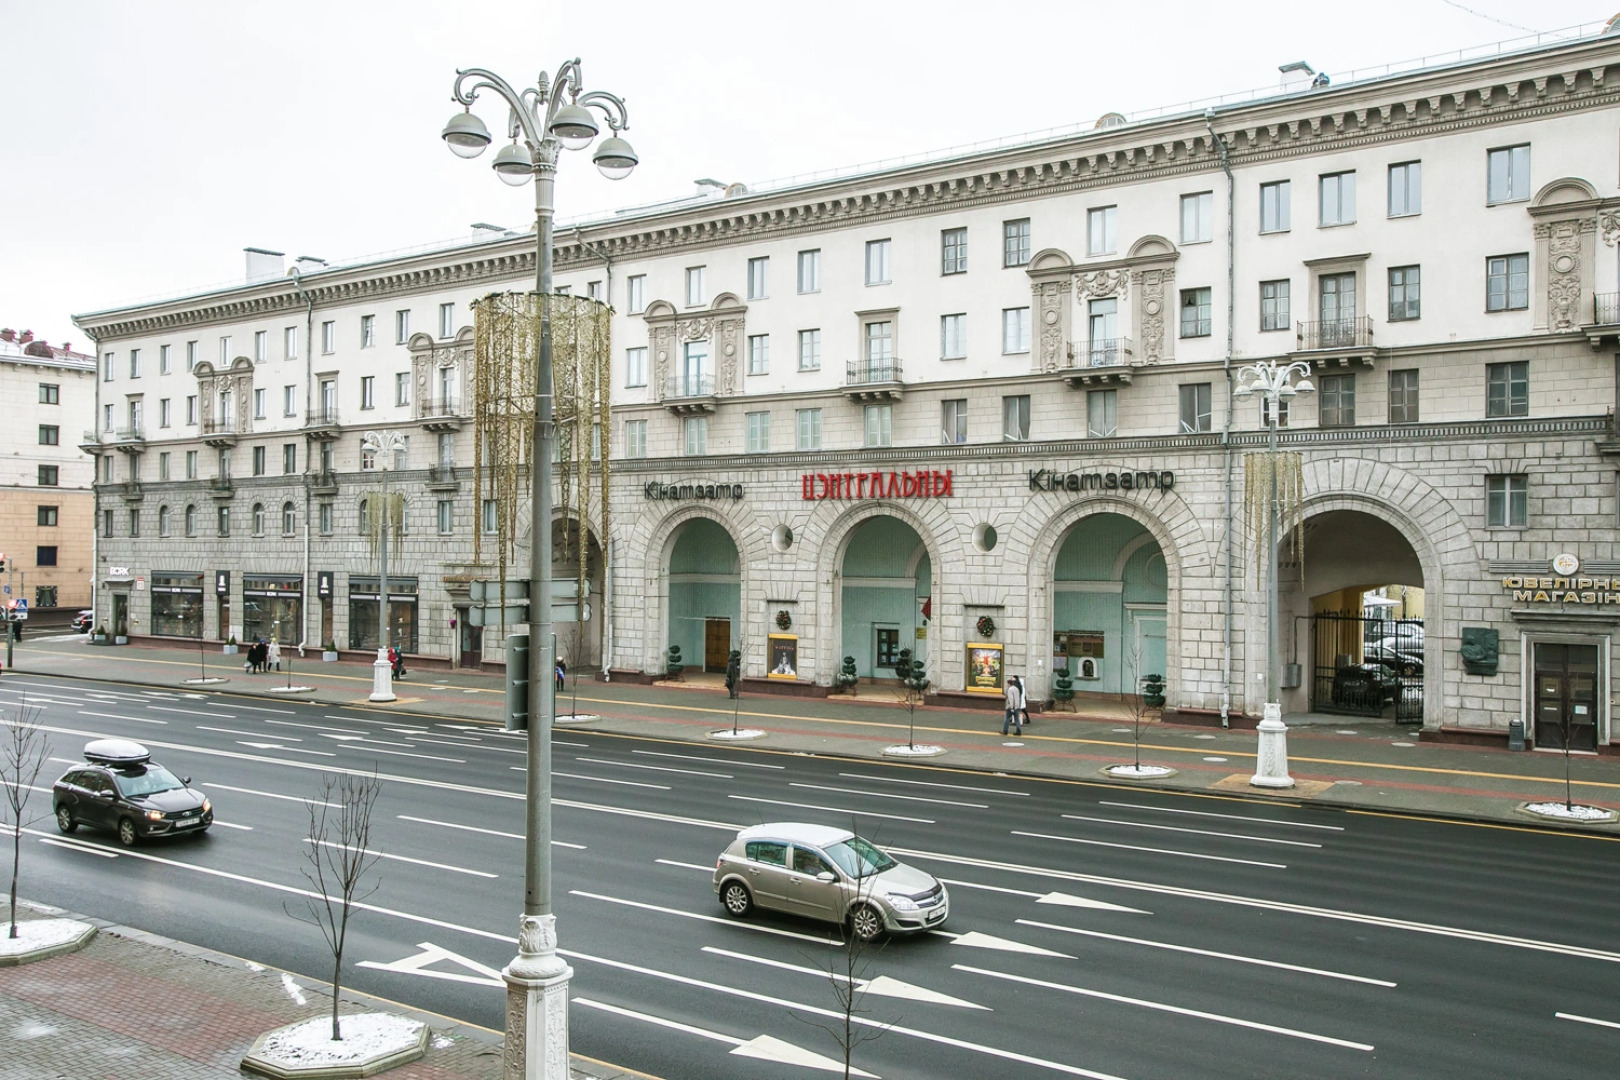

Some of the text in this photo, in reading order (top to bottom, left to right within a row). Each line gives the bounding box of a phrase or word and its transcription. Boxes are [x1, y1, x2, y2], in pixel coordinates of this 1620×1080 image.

[802, 469, 953, 500] ЦЭНТРАЛЬНЫ
[109, 567, 129, 576] BORK
[1512, 590, 1620, 604] МАГАЗІН
